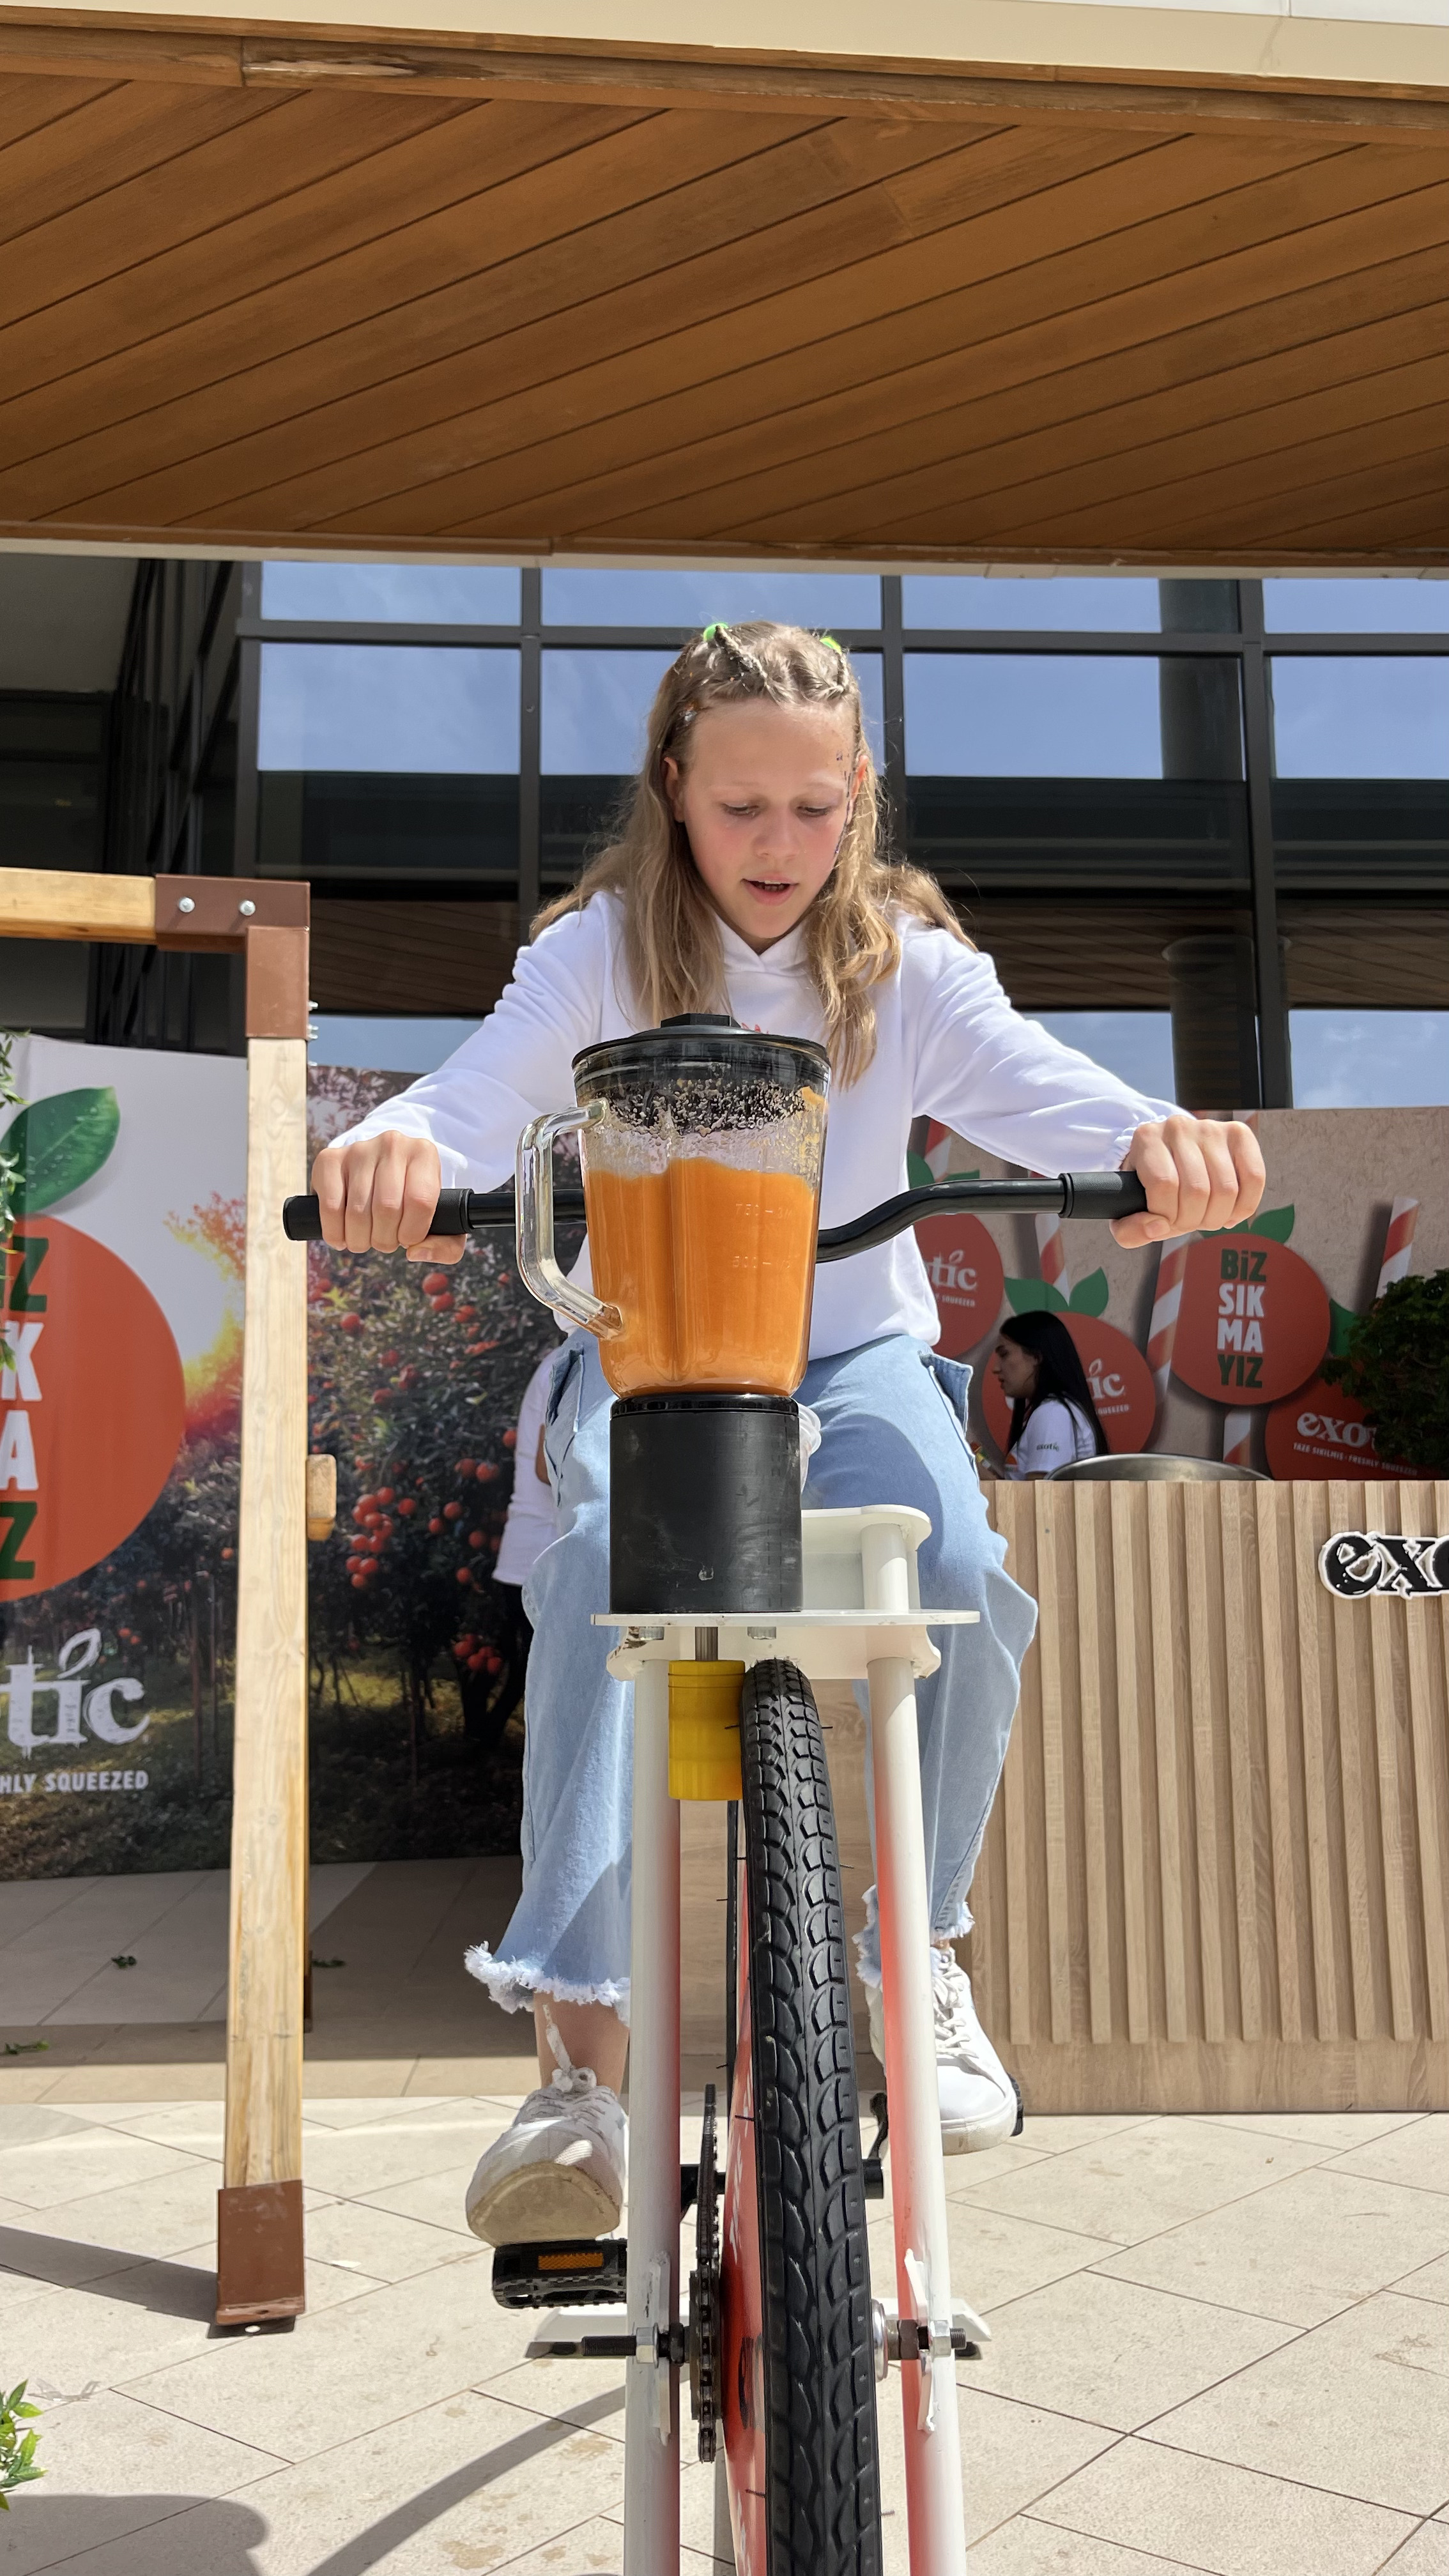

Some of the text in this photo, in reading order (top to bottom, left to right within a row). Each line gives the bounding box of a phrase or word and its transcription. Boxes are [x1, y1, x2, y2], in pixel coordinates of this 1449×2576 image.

[923, 1248, 977, 1291] tic
[1218, 1282, 1265, 1318] SIK
[1217, 1317, 1264, 1353] MA
[1217, 1354, 1263, 1388] YIZ
[0, 1409, 38, 1491] A
[1297, 1412, 1376, 1451] exo
[0, 1628, 151, 1759] tic
[0, 1769, 149, 1794] HLY SQUEEZED
